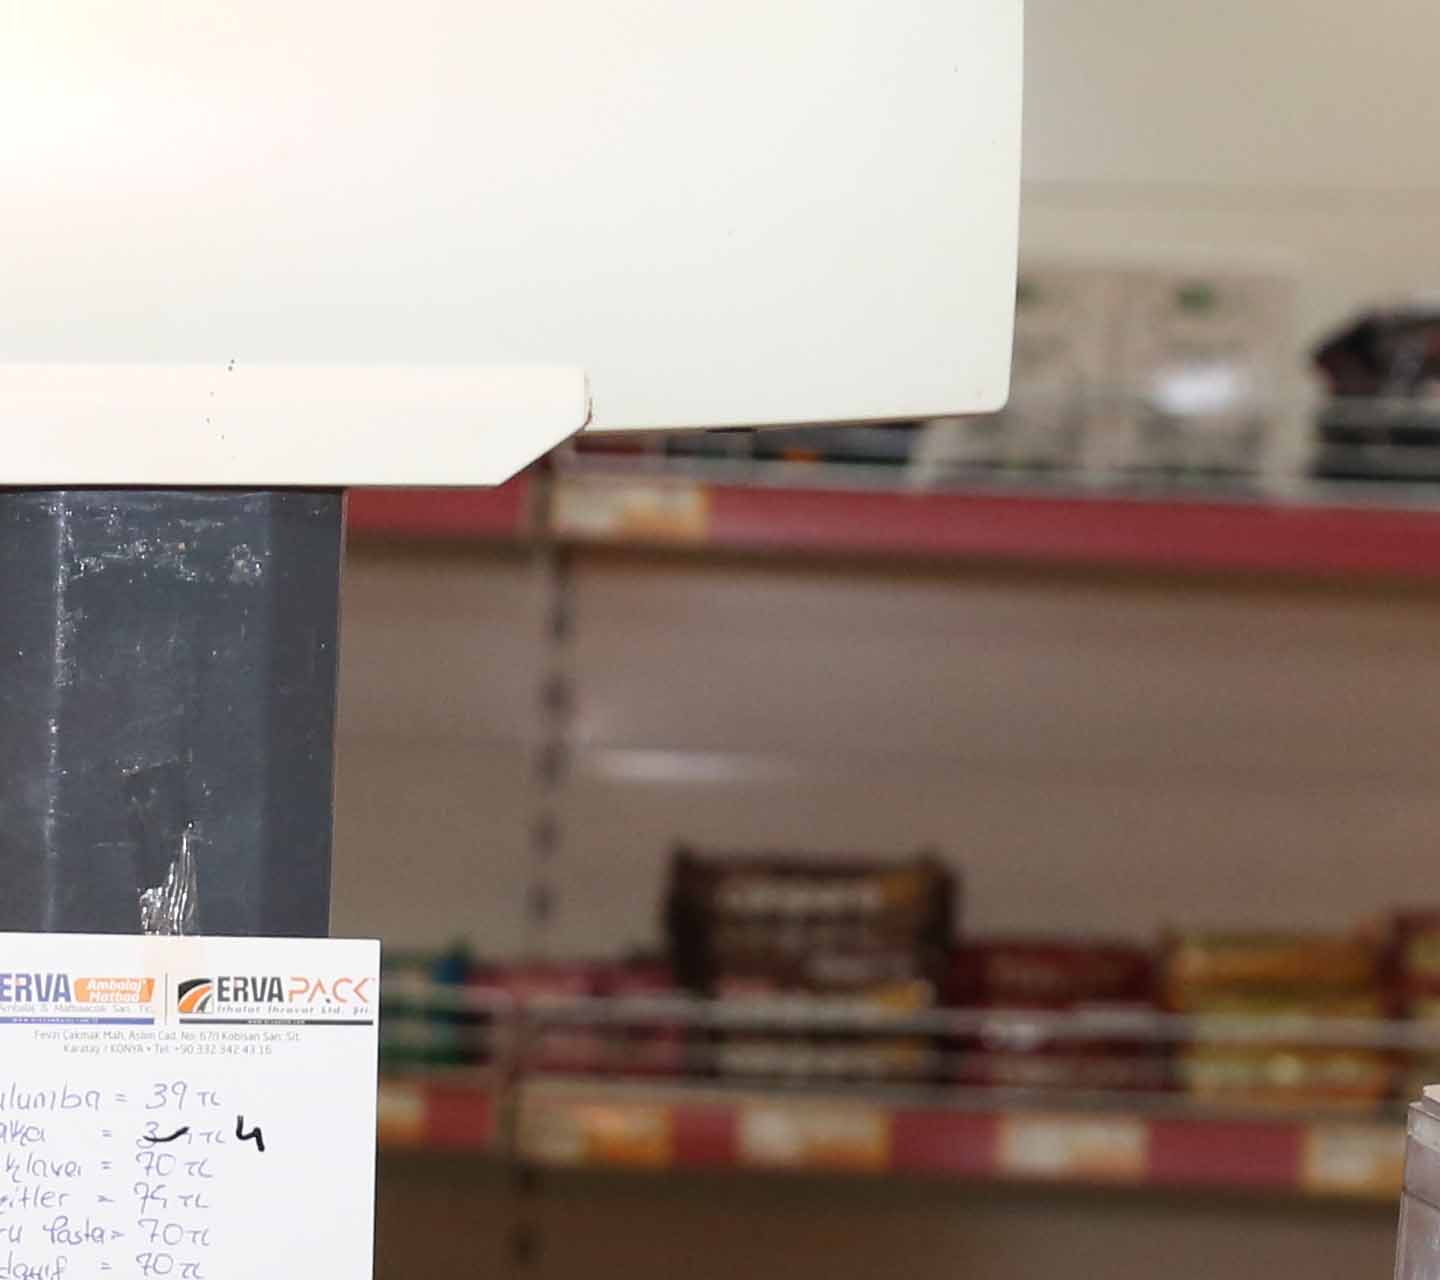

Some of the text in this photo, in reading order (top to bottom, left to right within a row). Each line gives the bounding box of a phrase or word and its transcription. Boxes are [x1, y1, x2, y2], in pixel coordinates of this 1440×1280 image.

[145, 1081, 188, 1111] 39
[135, 1151, 177, 1178] 70
[137, 1218, 184, 1246] 70
[135, 1252, 175, 1277] 70
